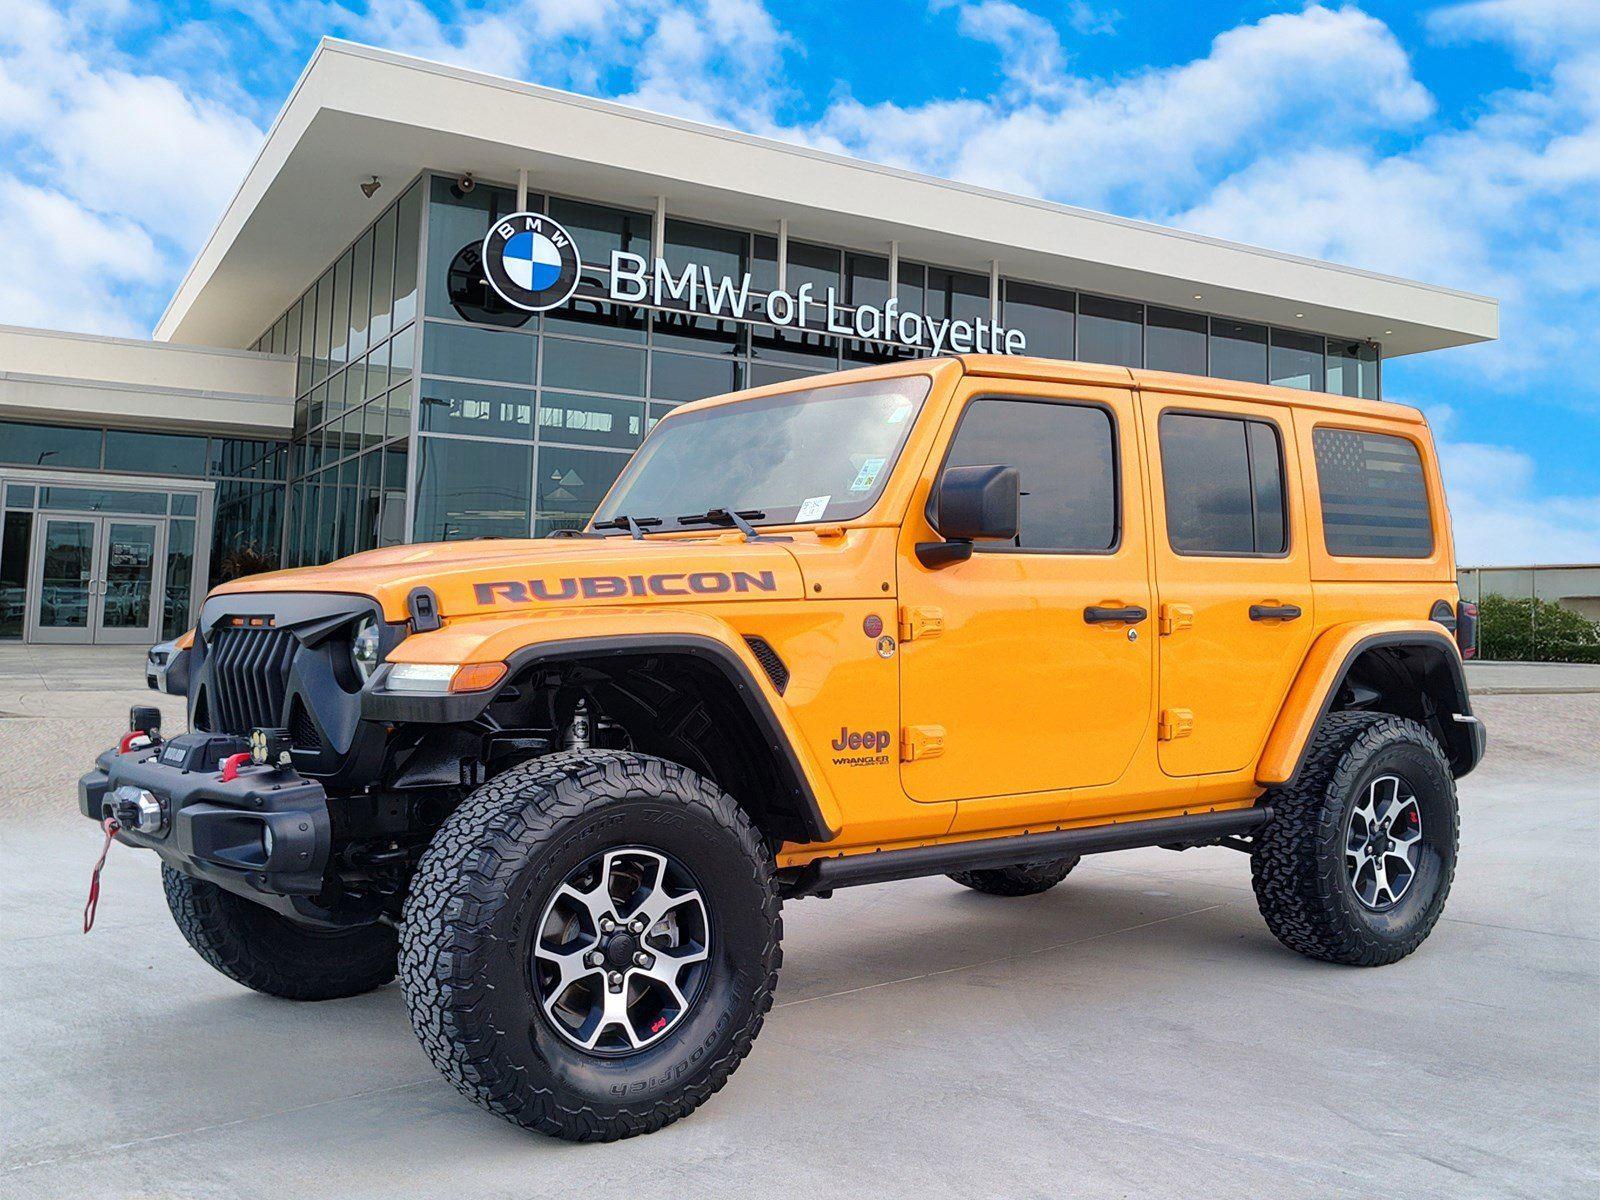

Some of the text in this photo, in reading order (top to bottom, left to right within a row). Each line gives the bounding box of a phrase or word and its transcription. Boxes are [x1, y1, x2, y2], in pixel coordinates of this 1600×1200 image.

[497, 217, 569, 249] BMW
[609, 250, 751, 318] BMW
[765, 282, 813, 327] of
[826, 286, 1026, 357] Lafayette
[473, 570, 777, 605] RUBICON
[831, 726, 891, 753] Jeep
[832, 755, 889, 765] WRANGLER
